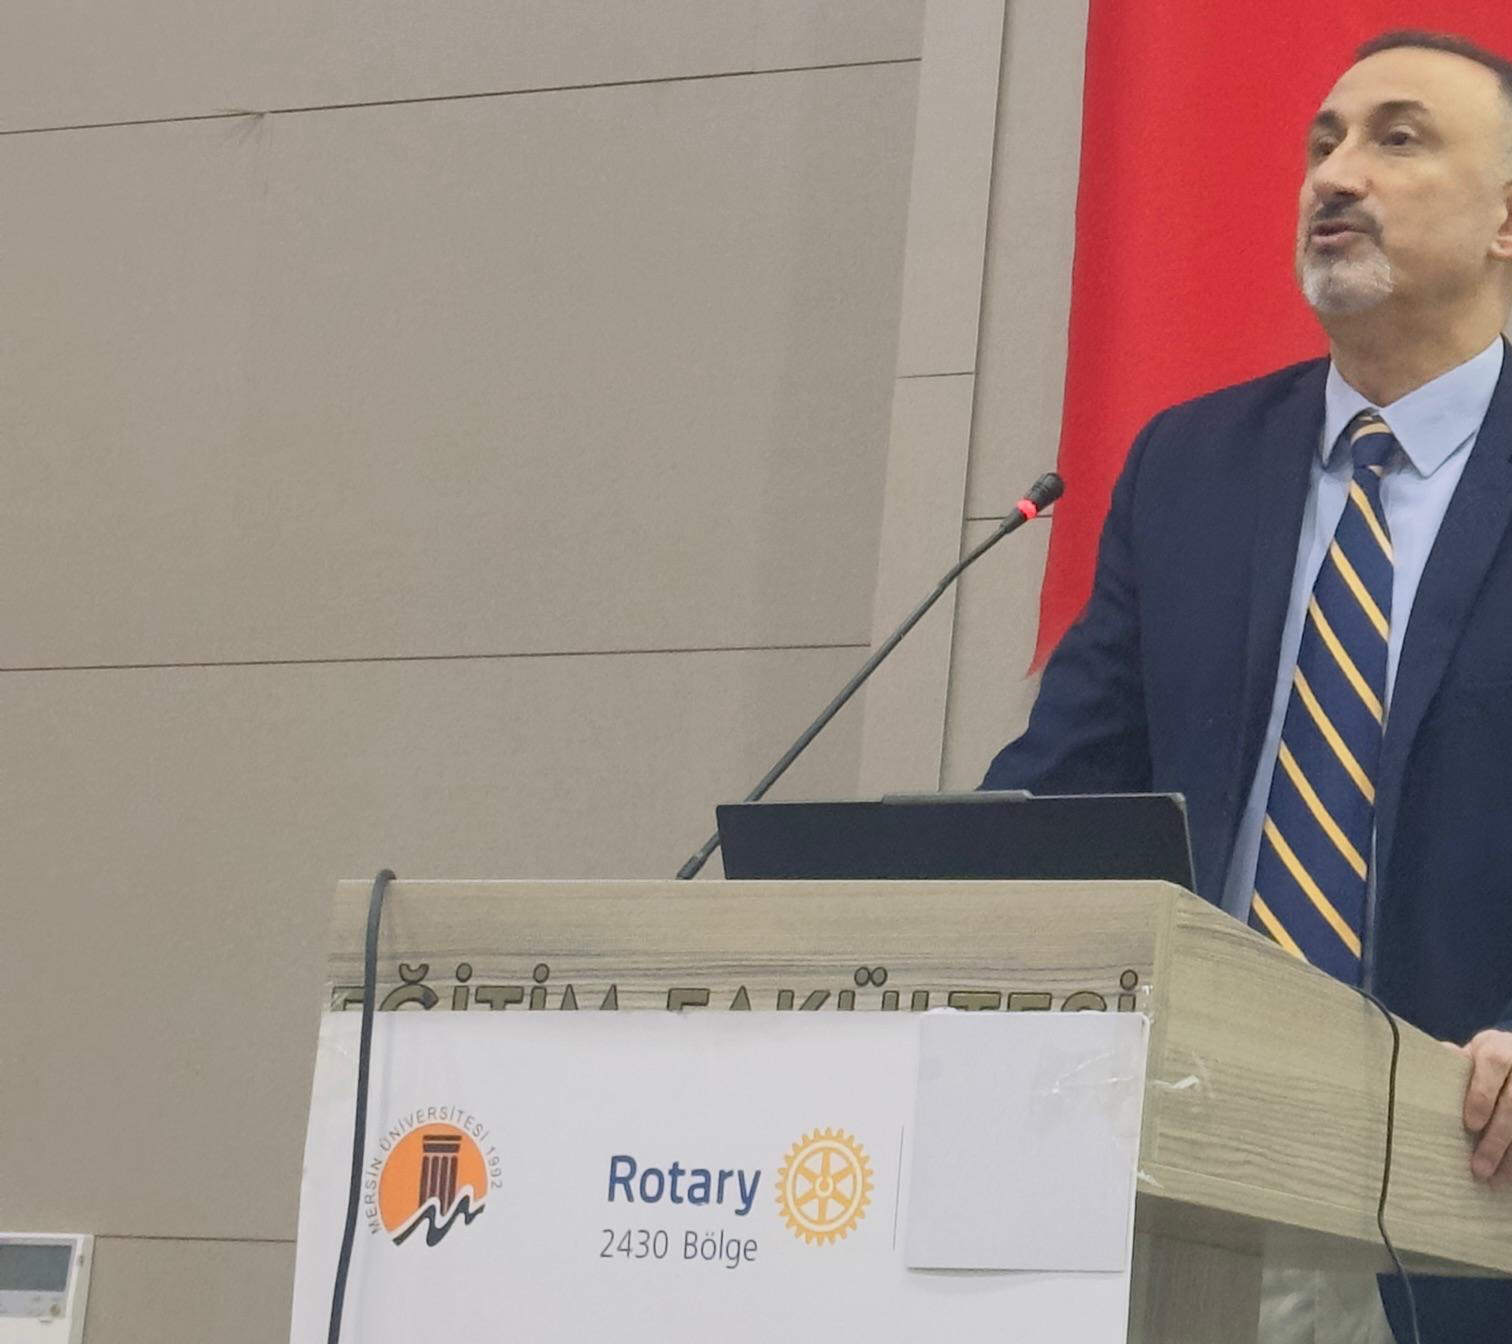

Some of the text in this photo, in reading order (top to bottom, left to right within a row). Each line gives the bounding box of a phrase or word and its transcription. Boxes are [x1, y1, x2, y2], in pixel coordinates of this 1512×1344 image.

[486, 1146, 503, 1189] 1992
[607, 1155, 762, 1216] Rotary
[600, 1228, 757, 1269] 2430 Bölge
